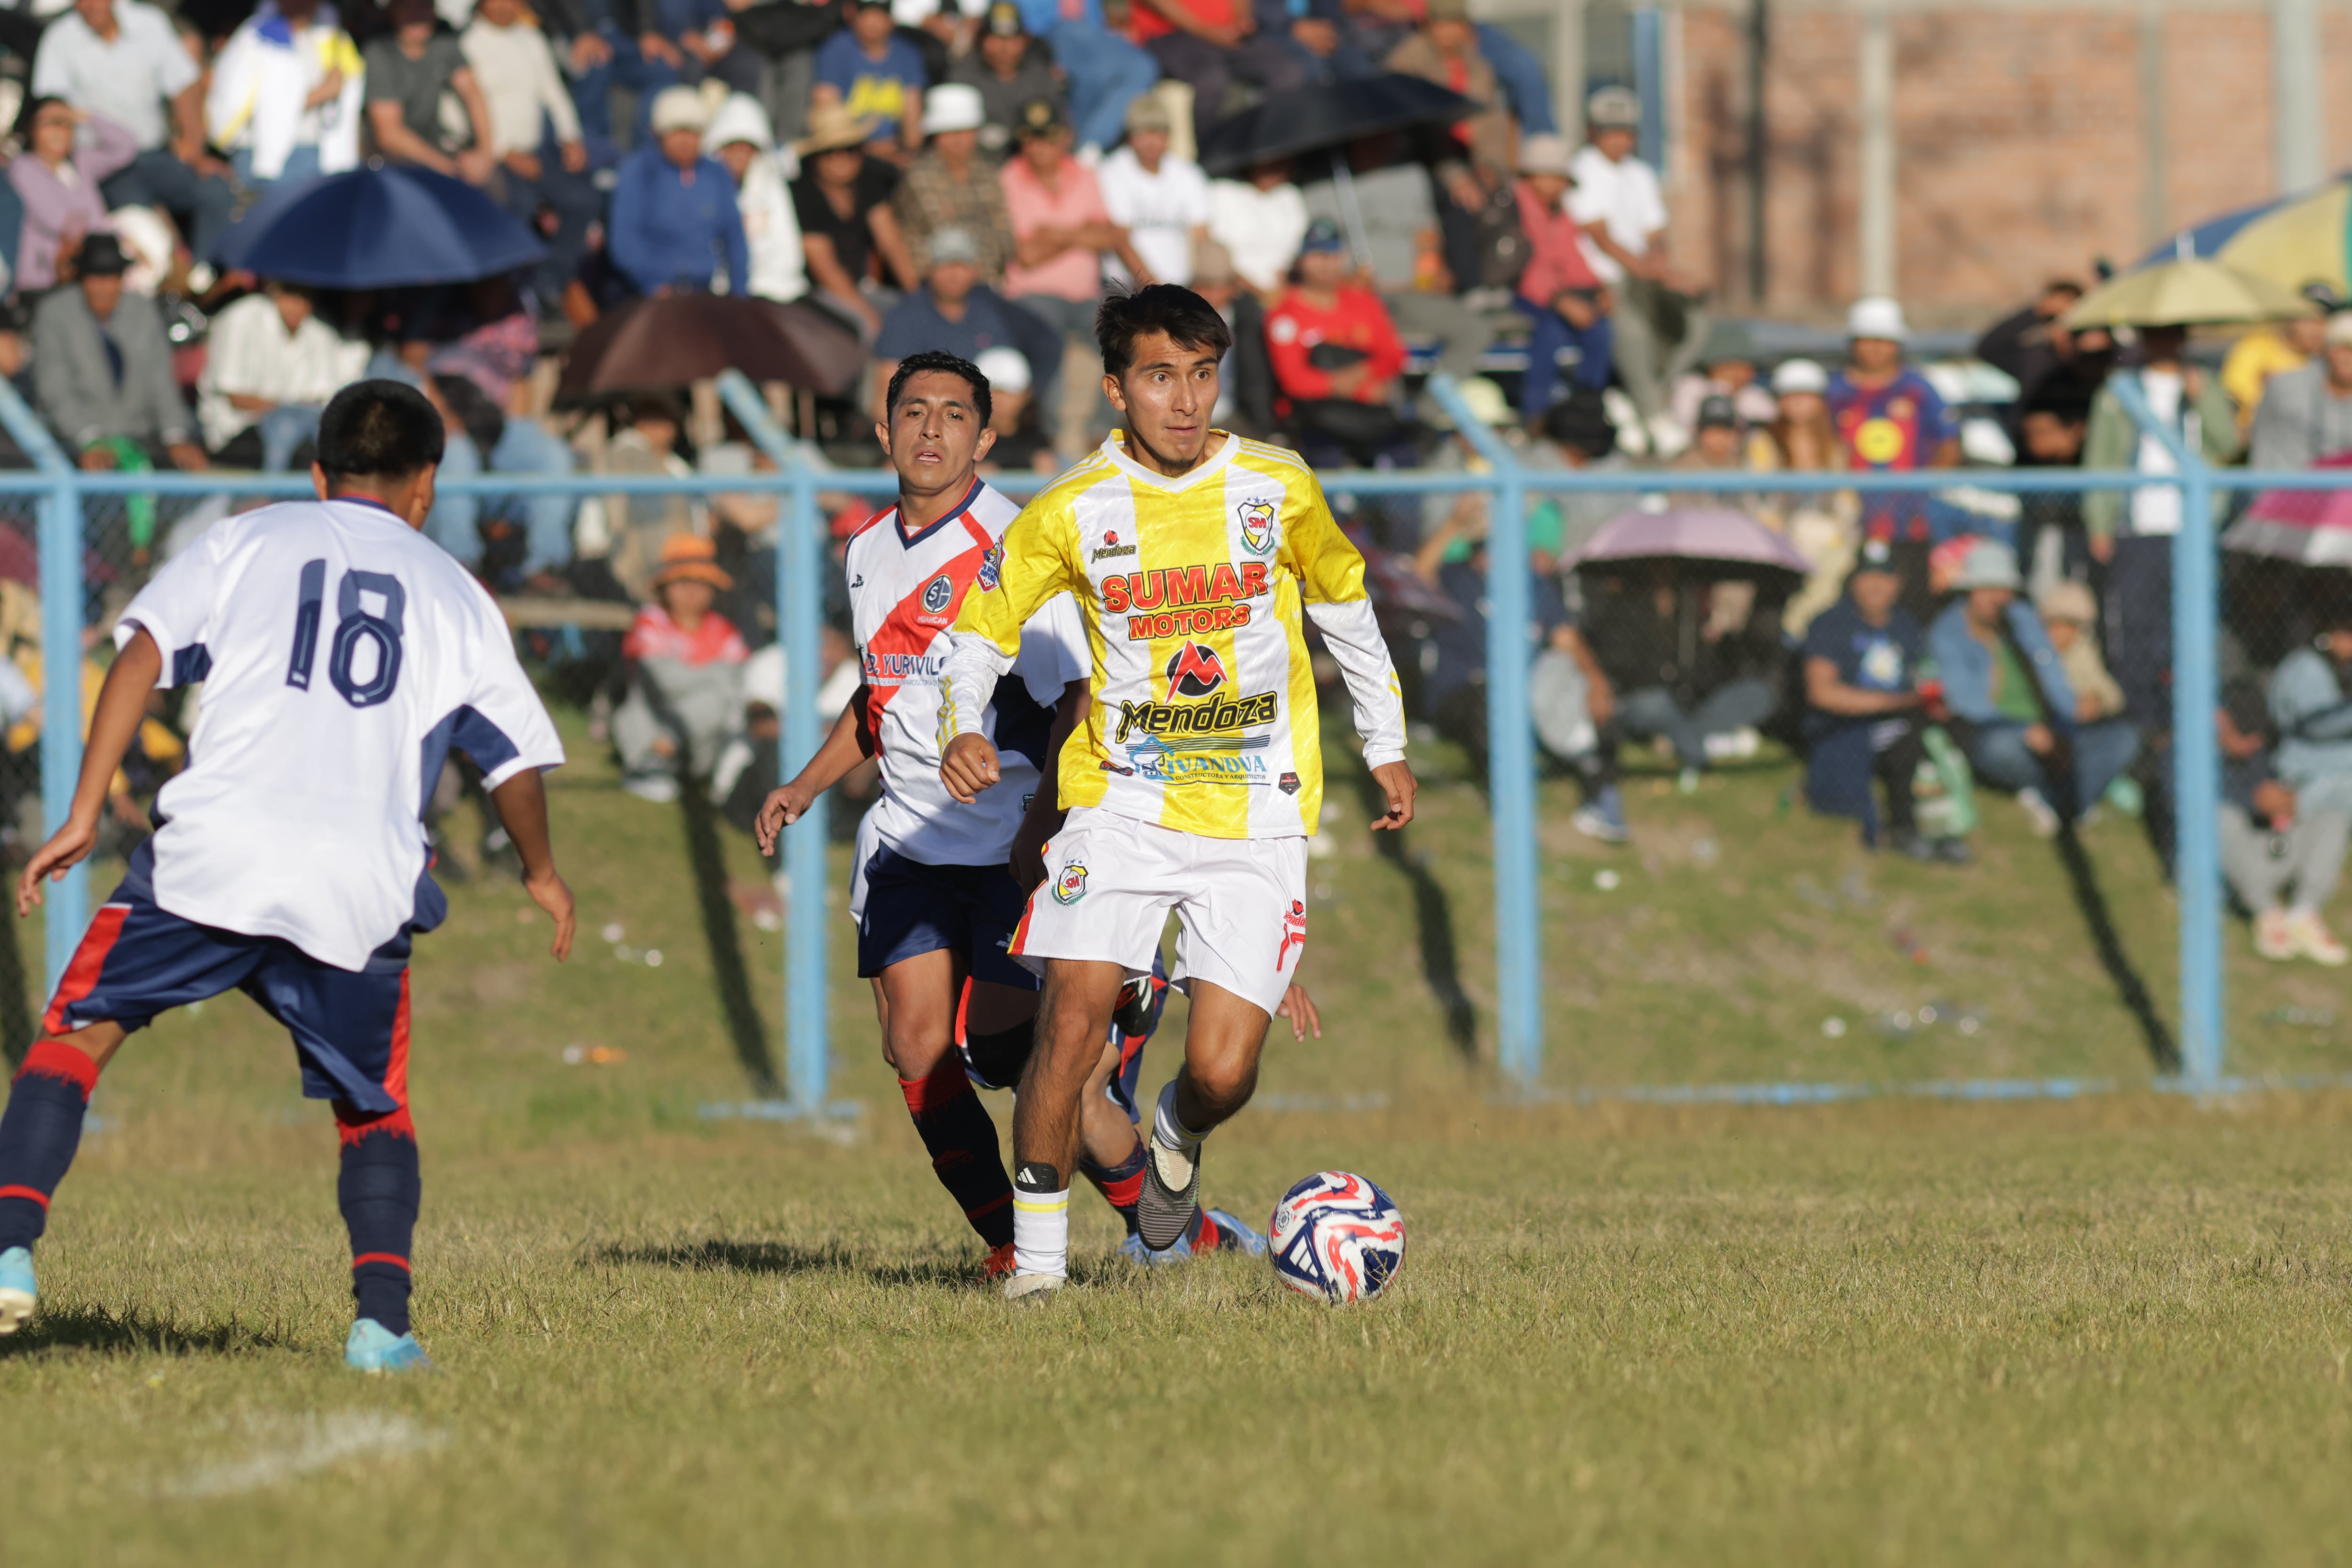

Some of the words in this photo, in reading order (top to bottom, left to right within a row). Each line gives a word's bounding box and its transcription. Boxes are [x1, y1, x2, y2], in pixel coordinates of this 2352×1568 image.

[1248, 517, 1267, 528] SM
[1091, 543, 1136, 564] Mendoza
[1101, 562, 1268, 613] SUMAR
[286, 558, 406, 708] 18
[1128, 604, 1251, 641] MOTORS
[1115, 691, 1277, 744] Mendoza
[1064, 875, 1080, 889] SM
